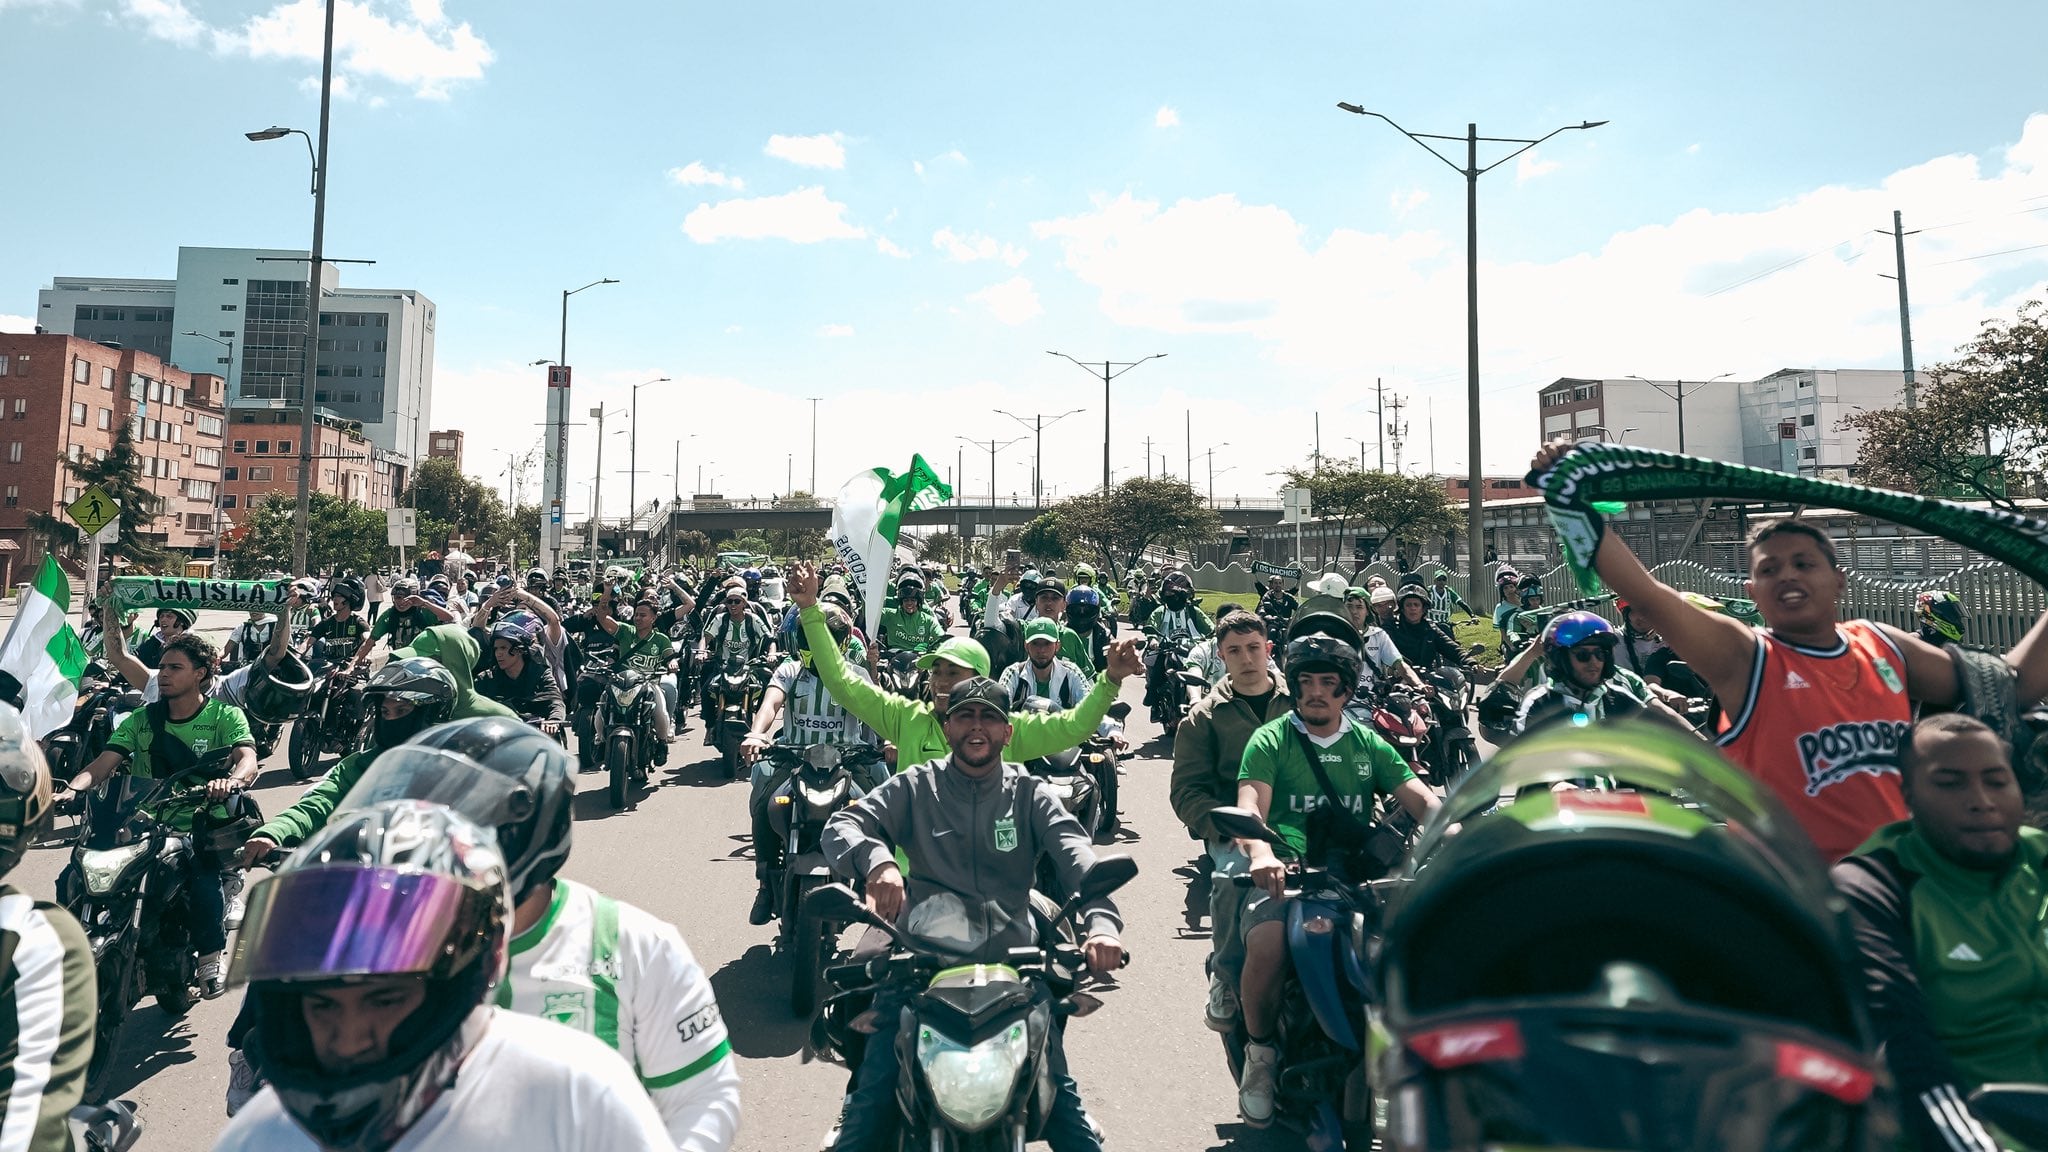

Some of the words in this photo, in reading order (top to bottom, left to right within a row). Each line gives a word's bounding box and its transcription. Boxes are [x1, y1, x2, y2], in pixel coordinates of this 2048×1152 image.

[1269, 567, 1298, 577] NACHOS
[154, 578, 194, 602] LA
[200, 580, 266, 603] ISLA
